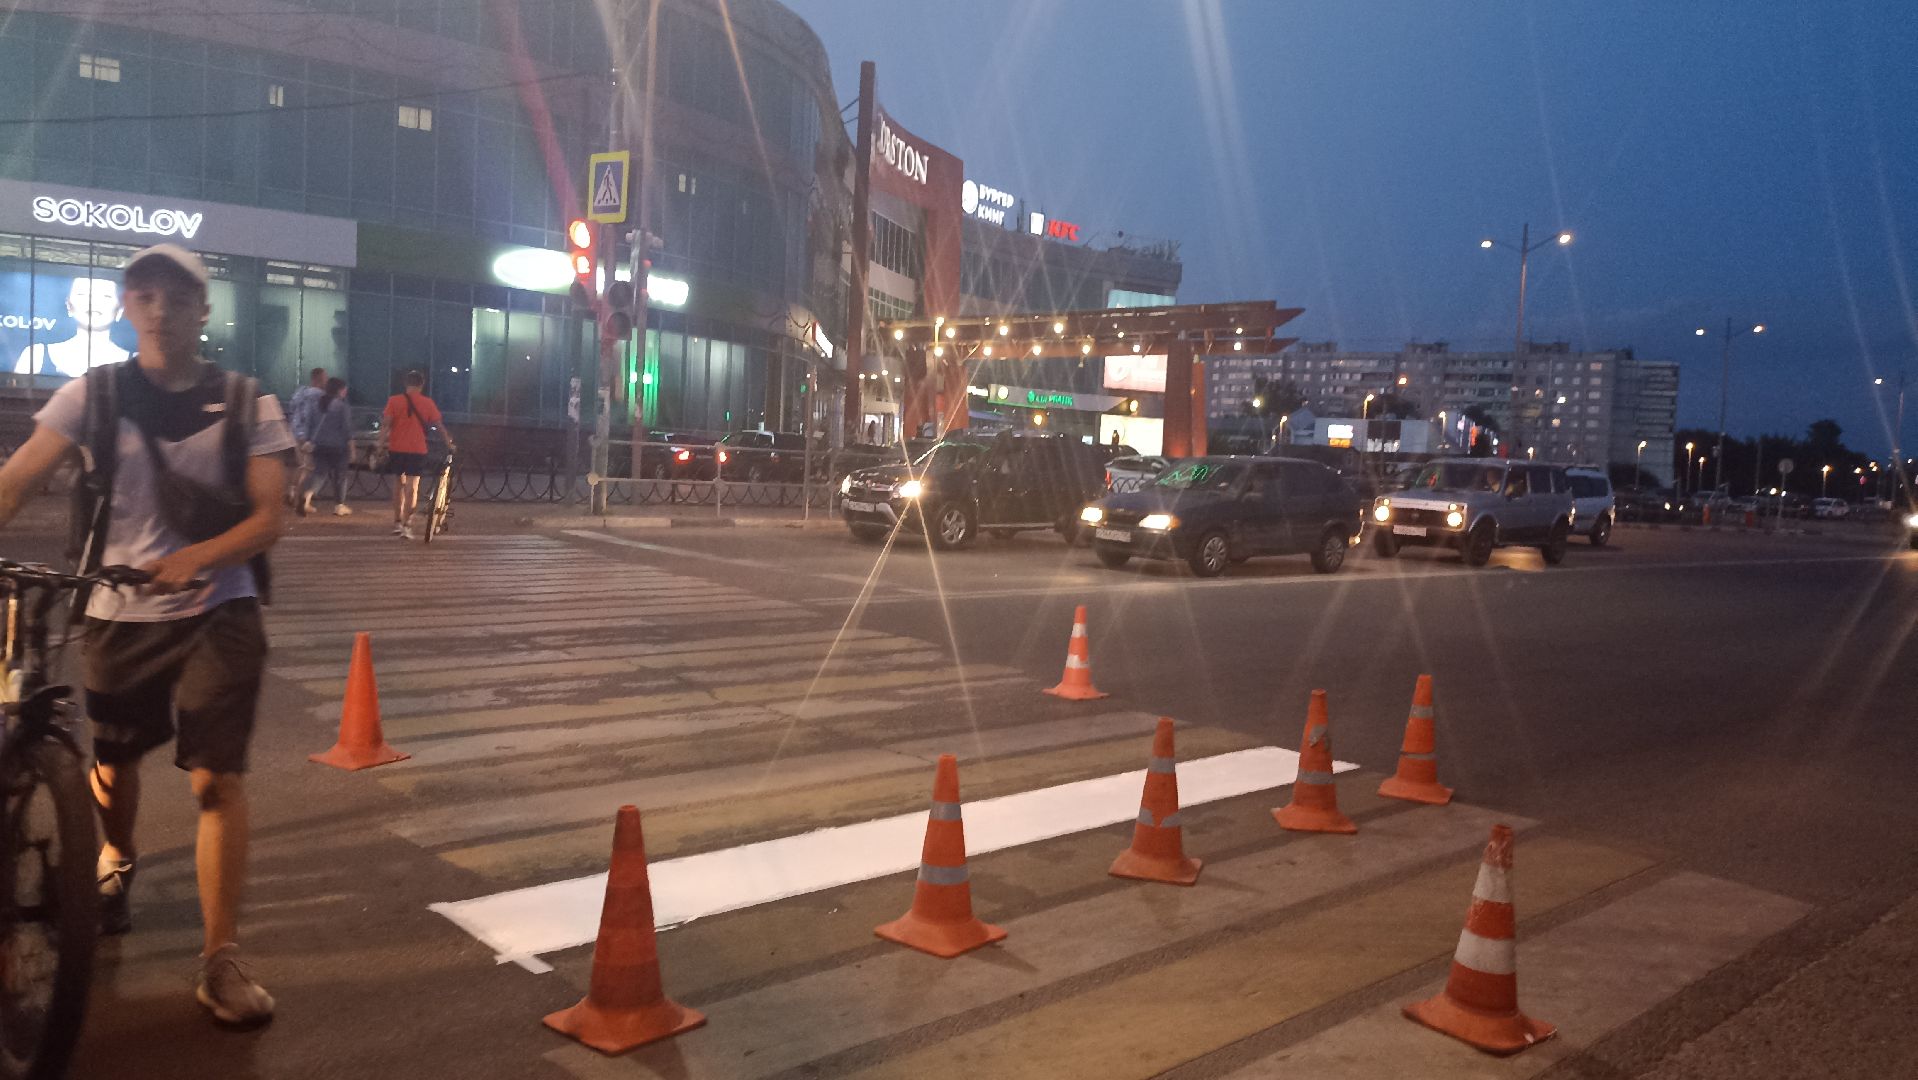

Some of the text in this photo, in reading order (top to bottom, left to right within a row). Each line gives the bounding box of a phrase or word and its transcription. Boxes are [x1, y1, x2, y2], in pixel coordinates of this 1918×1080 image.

[979, 184, 1014, 208] БУРГЕР
[33, 196, 203, 239] SOKOLOV
[978, 204, 1004, 225] КИНГ
[1047, 219, 1081, 242] KFC
[0, 314, 57, 331] OLOV
